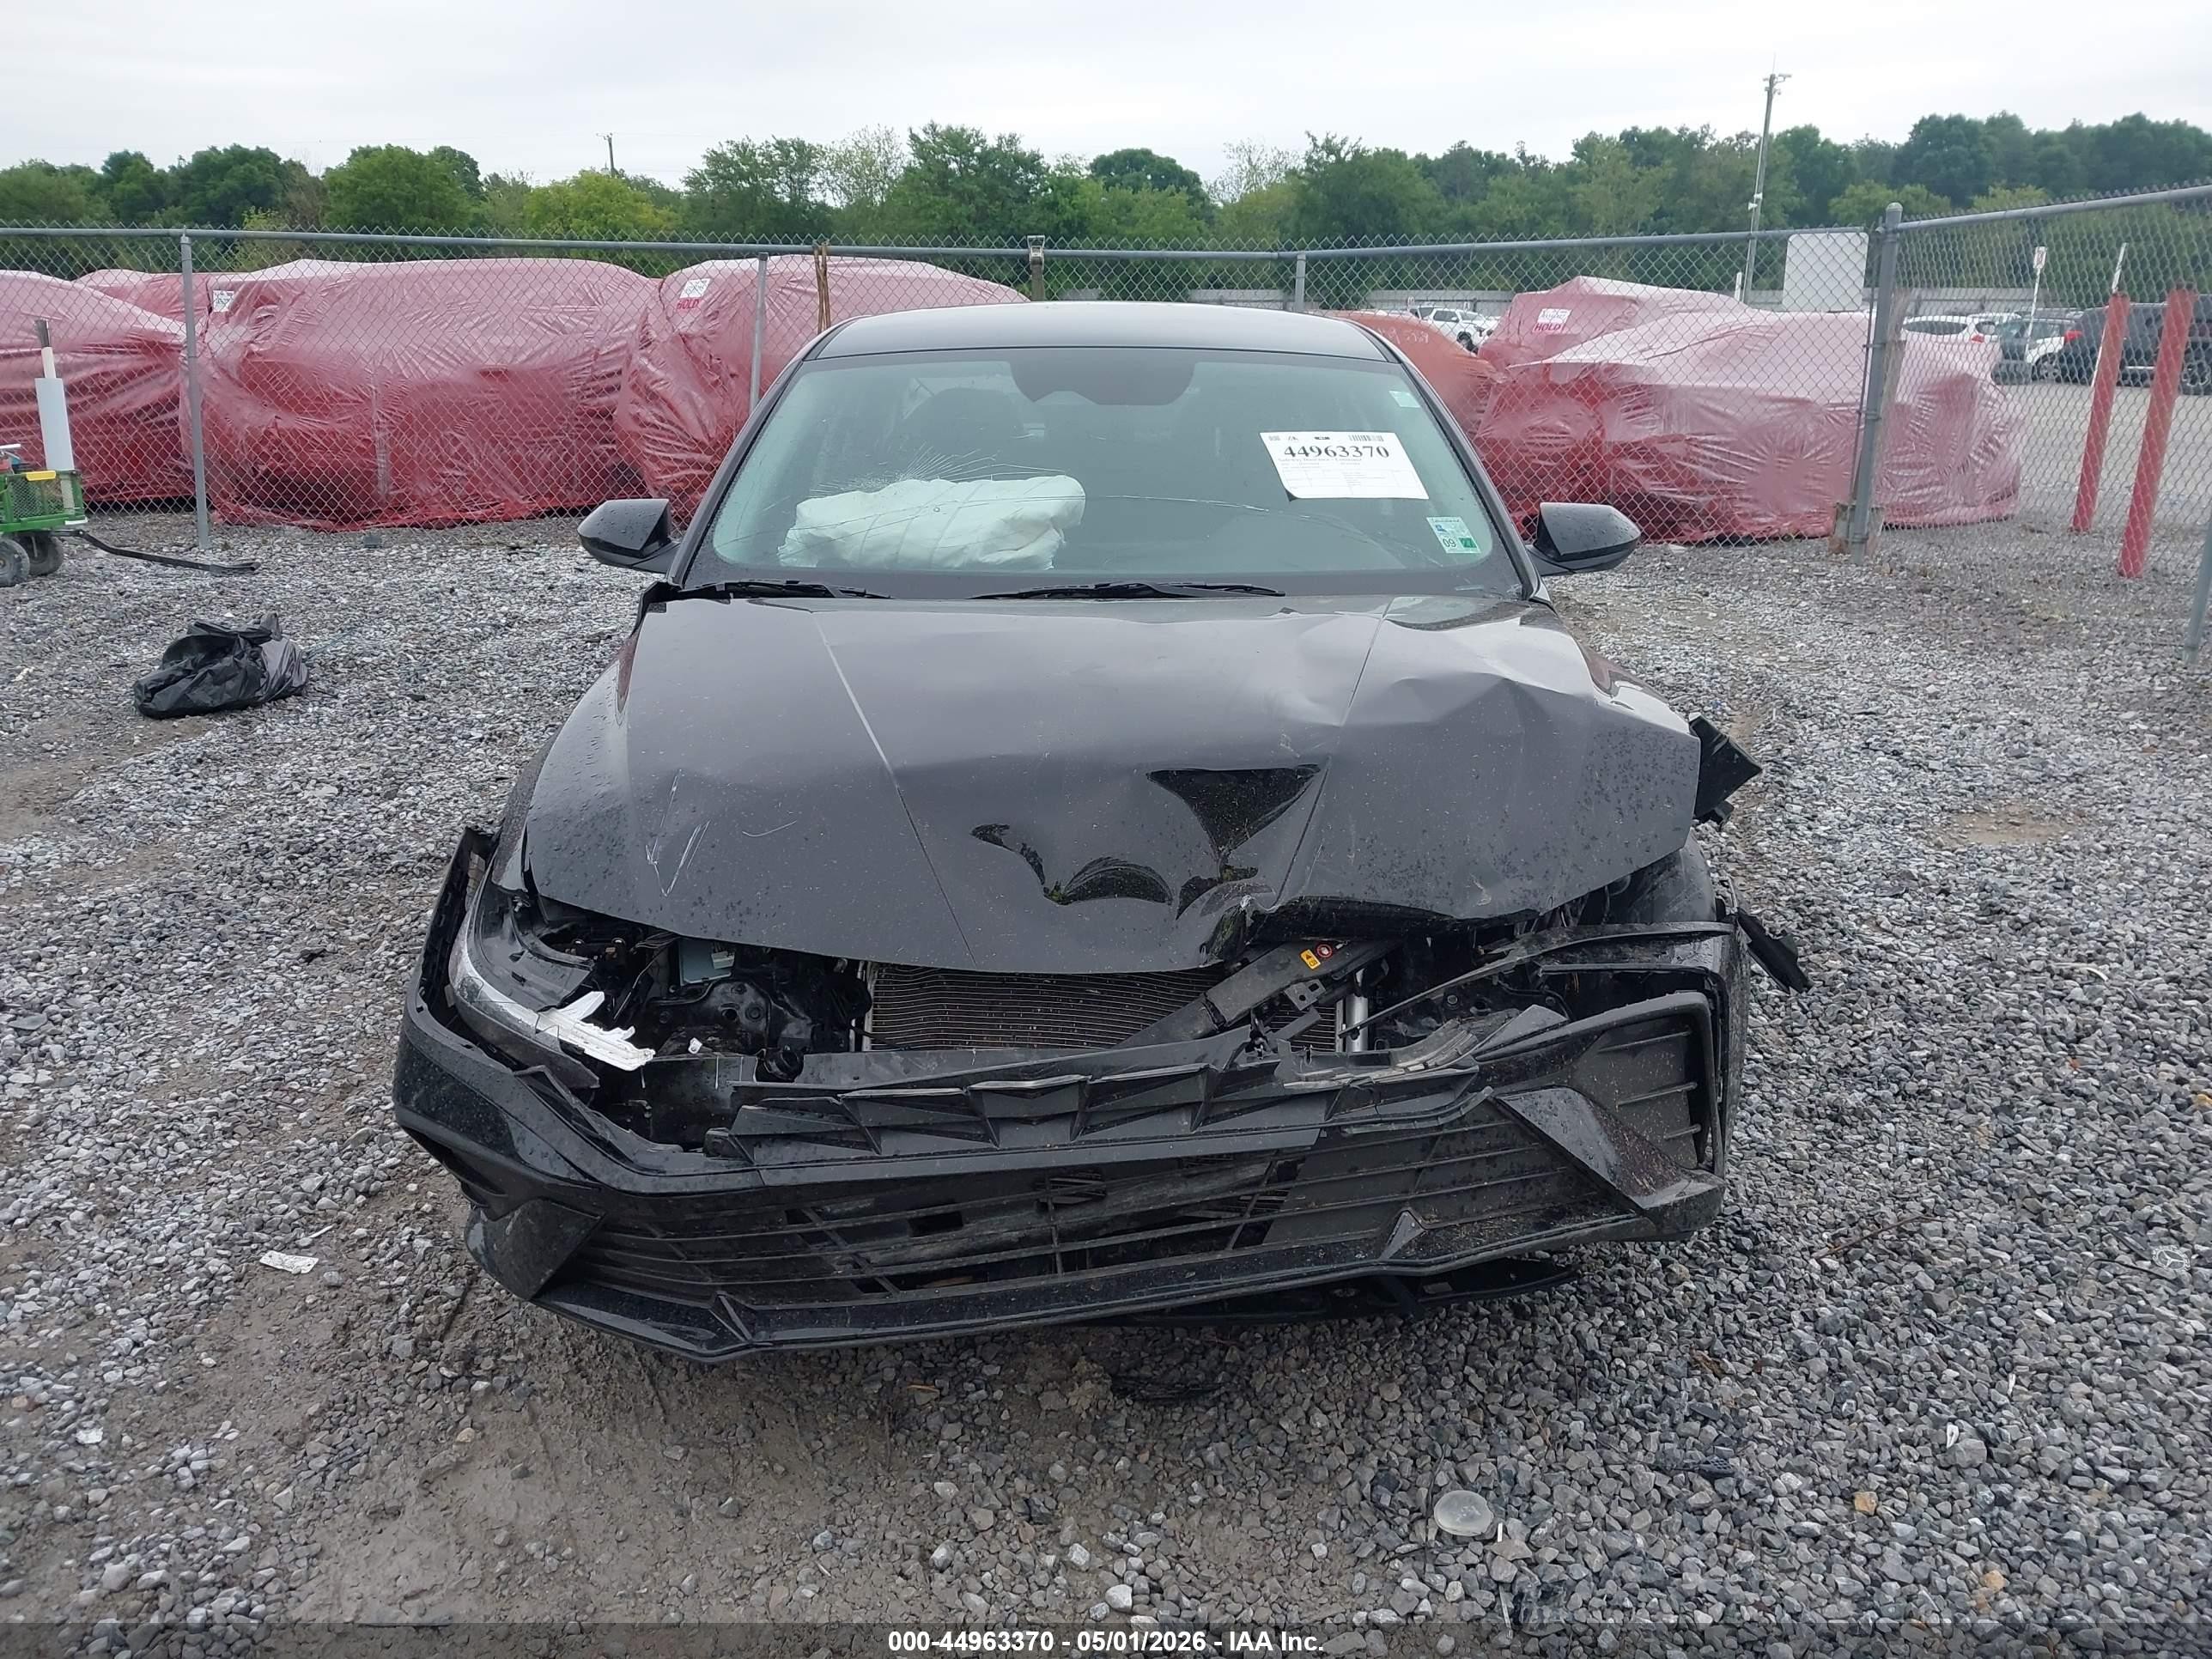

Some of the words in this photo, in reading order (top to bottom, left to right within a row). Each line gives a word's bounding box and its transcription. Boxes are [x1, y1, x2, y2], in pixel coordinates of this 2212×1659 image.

[677, 299, 699, 309] HOLD
[1534, 322, 1561, 331] HOLD
[1284, 446, 1389, 458] 44963370
[1443, 538, 1456, 548] 09
